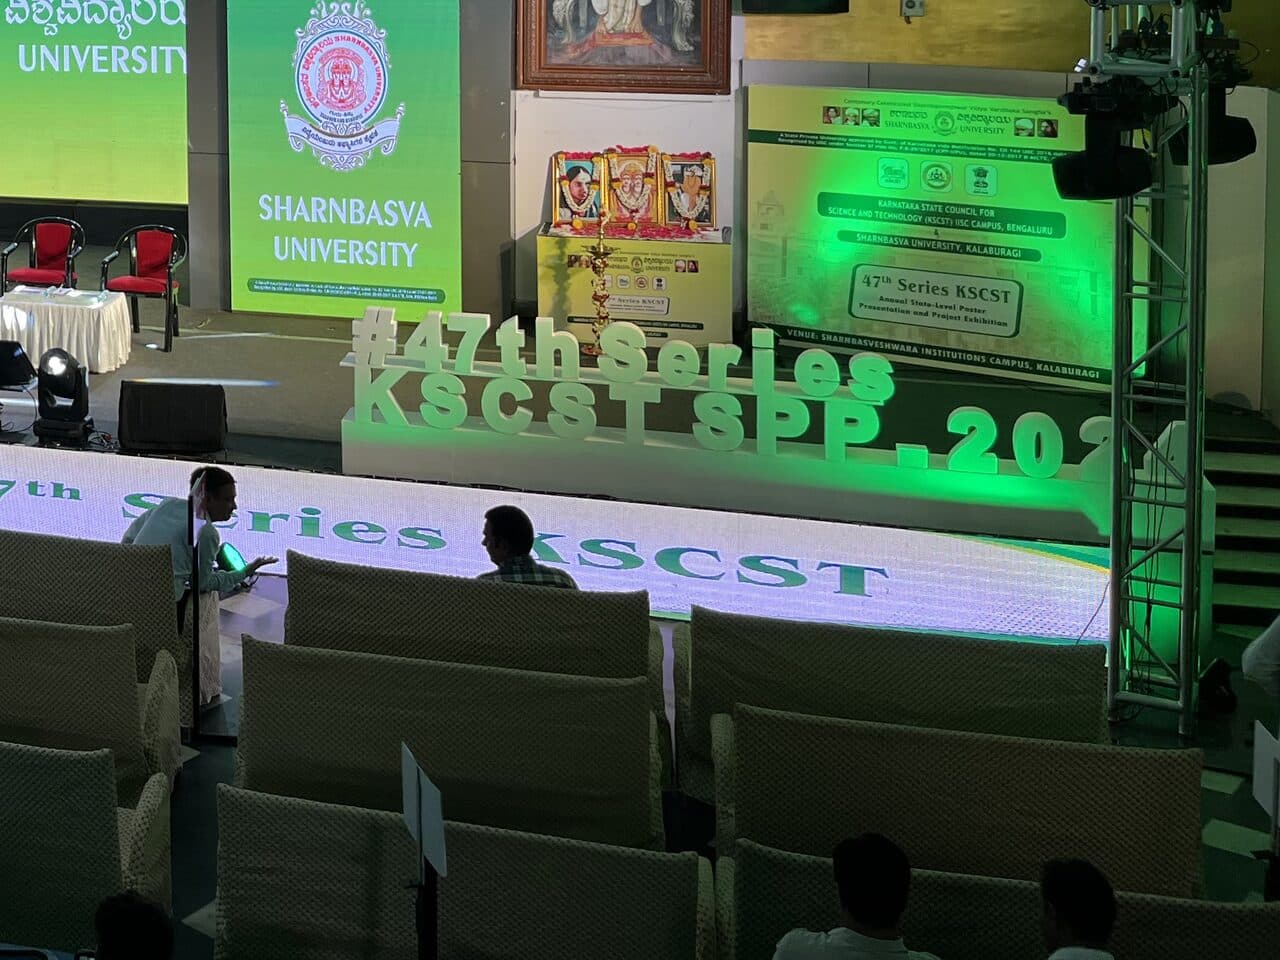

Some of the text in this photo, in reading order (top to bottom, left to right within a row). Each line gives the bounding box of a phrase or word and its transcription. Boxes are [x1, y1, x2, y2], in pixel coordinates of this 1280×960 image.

[258, 193, 433, 228] SHARNBASVA
[828, 207, 857, 217] SCIENCE
[858, 209, 873, 218] AND
[874, 211, 923, 222] TECHNOLOGY
[924, 216, 953, 227] (KSCST)
[971, 219, 1004, 231] CAMPUS,
[1006, 223, 1053, 235] BENGALURU
[878, 199, 995, 217] KARNATAKA STATE COUNCIL FOR
[274, 235, 418, 268] UNIVERSITY
[856, 233, 1022, 258] SHARNBASVA UNIVERSITY, KALABURAGI
[862, 274, 1011, 304] 47th Series KSCST
[858, 301, 1009, 328] Presentation and Project Exhibition
[879, 295, 987, 315] Annual State-Level Poster
[787, 328, 1100, 379] VENUE: SHARNBASVESHWARA INSTITUTIONS CAMPUS, KALABURAGI
[355, 367, 662, 446] KSCST
[121, 491, 447, 551] Sries
